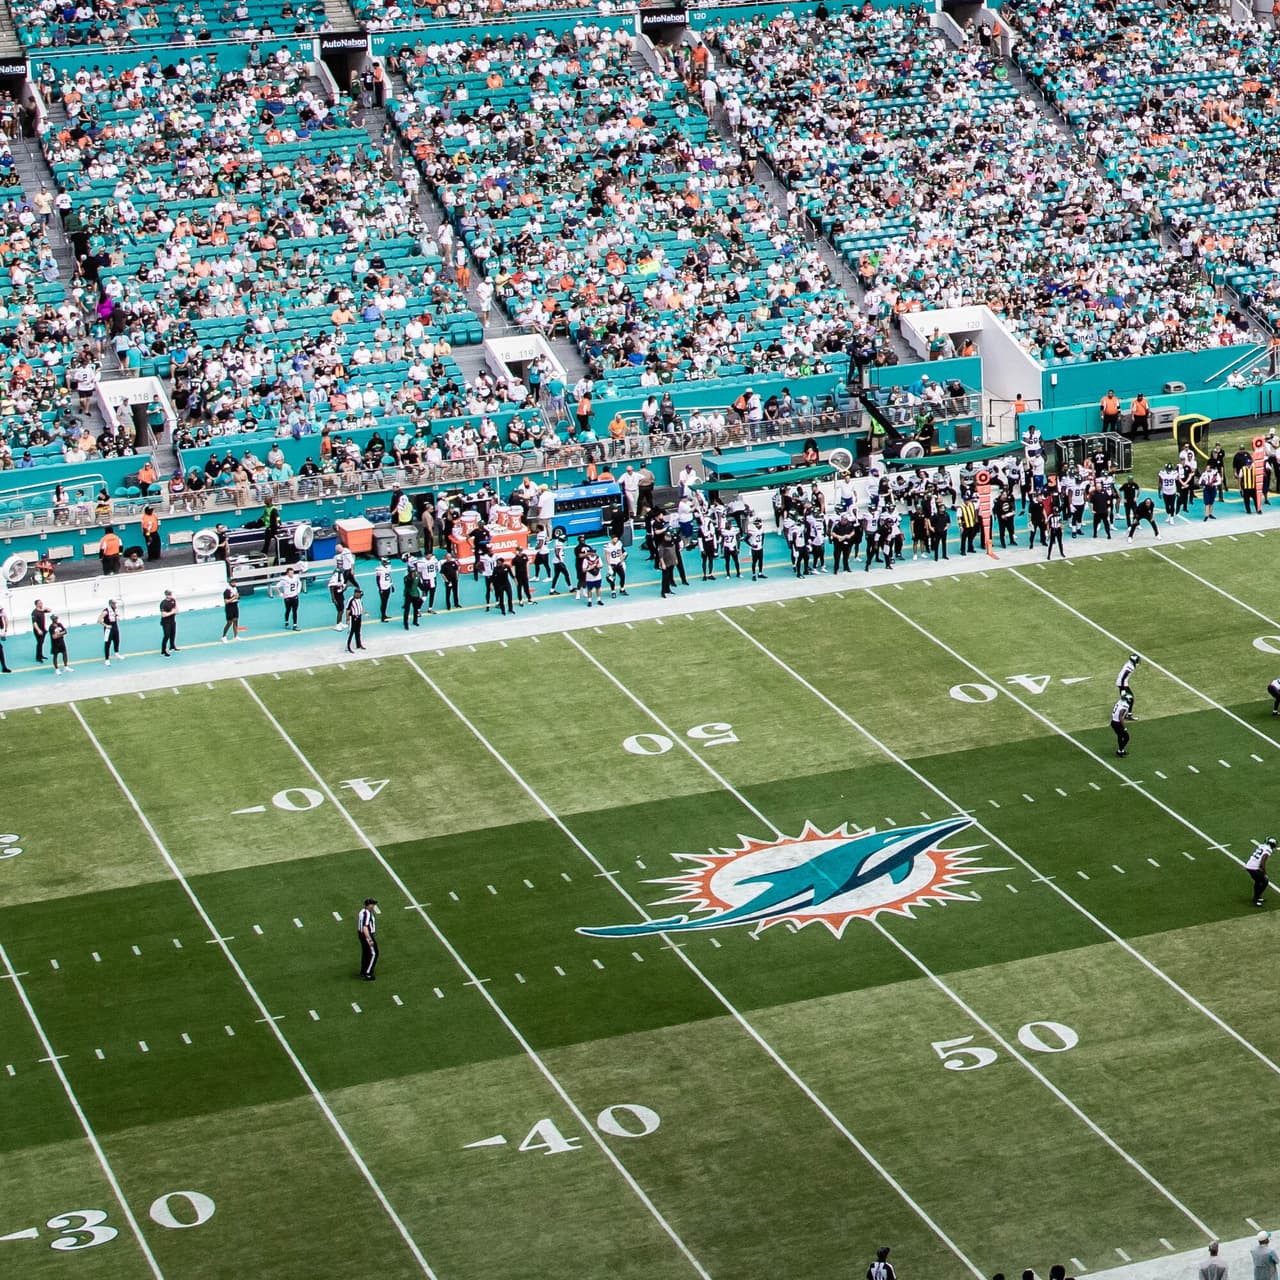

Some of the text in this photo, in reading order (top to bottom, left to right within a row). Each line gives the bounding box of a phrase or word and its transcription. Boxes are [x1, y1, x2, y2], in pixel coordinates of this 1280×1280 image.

[694, 12, 706, 20] 120
[299, 42, 311, 51] 118
[322, 38, 368, 49] AutoNation
[949, 673, 1051, 704] 40
[622, 721, 740, 756] 50
[271, 776, 391, 812] 40
[931, 1020, 1079, 1071] 50
[519, 1104, 661, 1155] 40
[46, 1190, 216, 1251] 30
